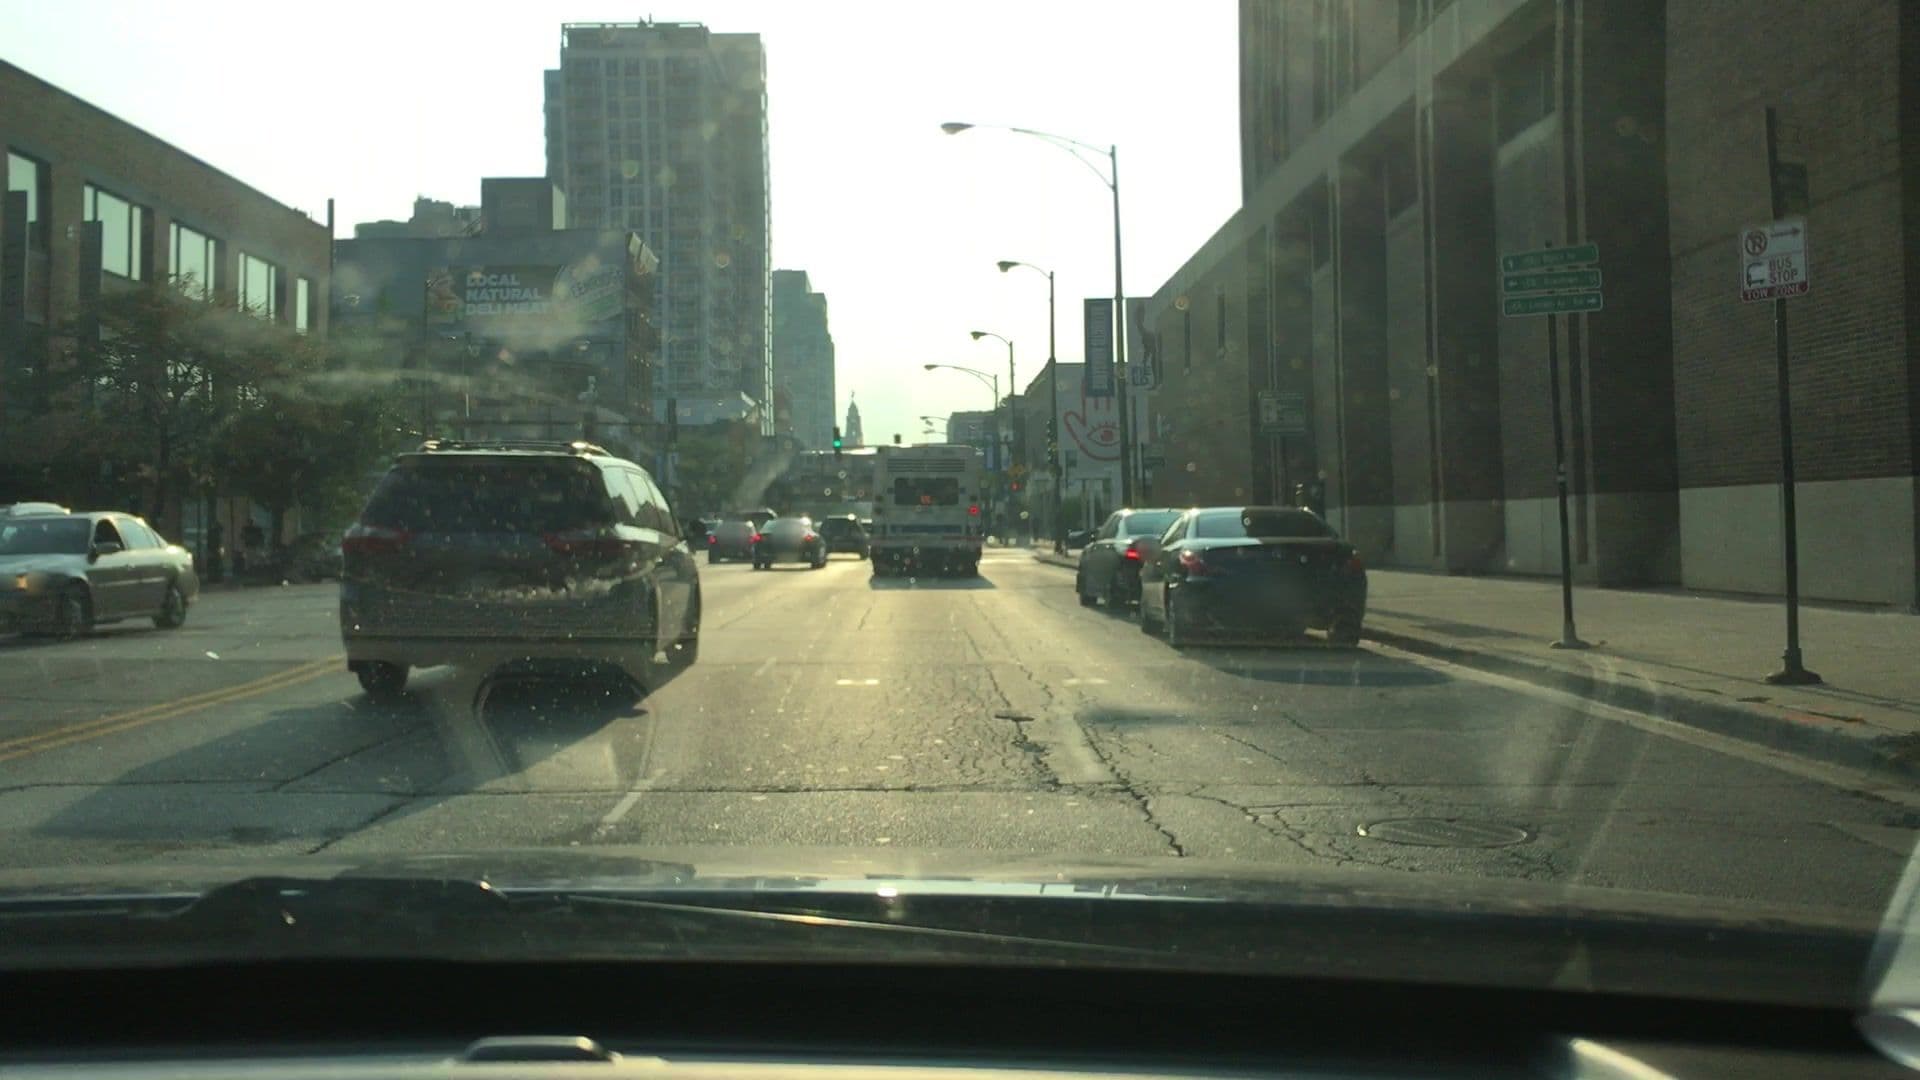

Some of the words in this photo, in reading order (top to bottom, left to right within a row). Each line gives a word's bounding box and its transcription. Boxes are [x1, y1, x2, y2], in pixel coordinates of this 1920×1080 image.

[1769, 256, 1791, 270] BUS
[466, 274, 520, 287] LOCAL
[1769, 269, 1798, 283] STOP
[466, 288, 542, 301] NATURAL
[1747, 288, 1769, 300] TOW
[466, 303, 501, 315] DELI
